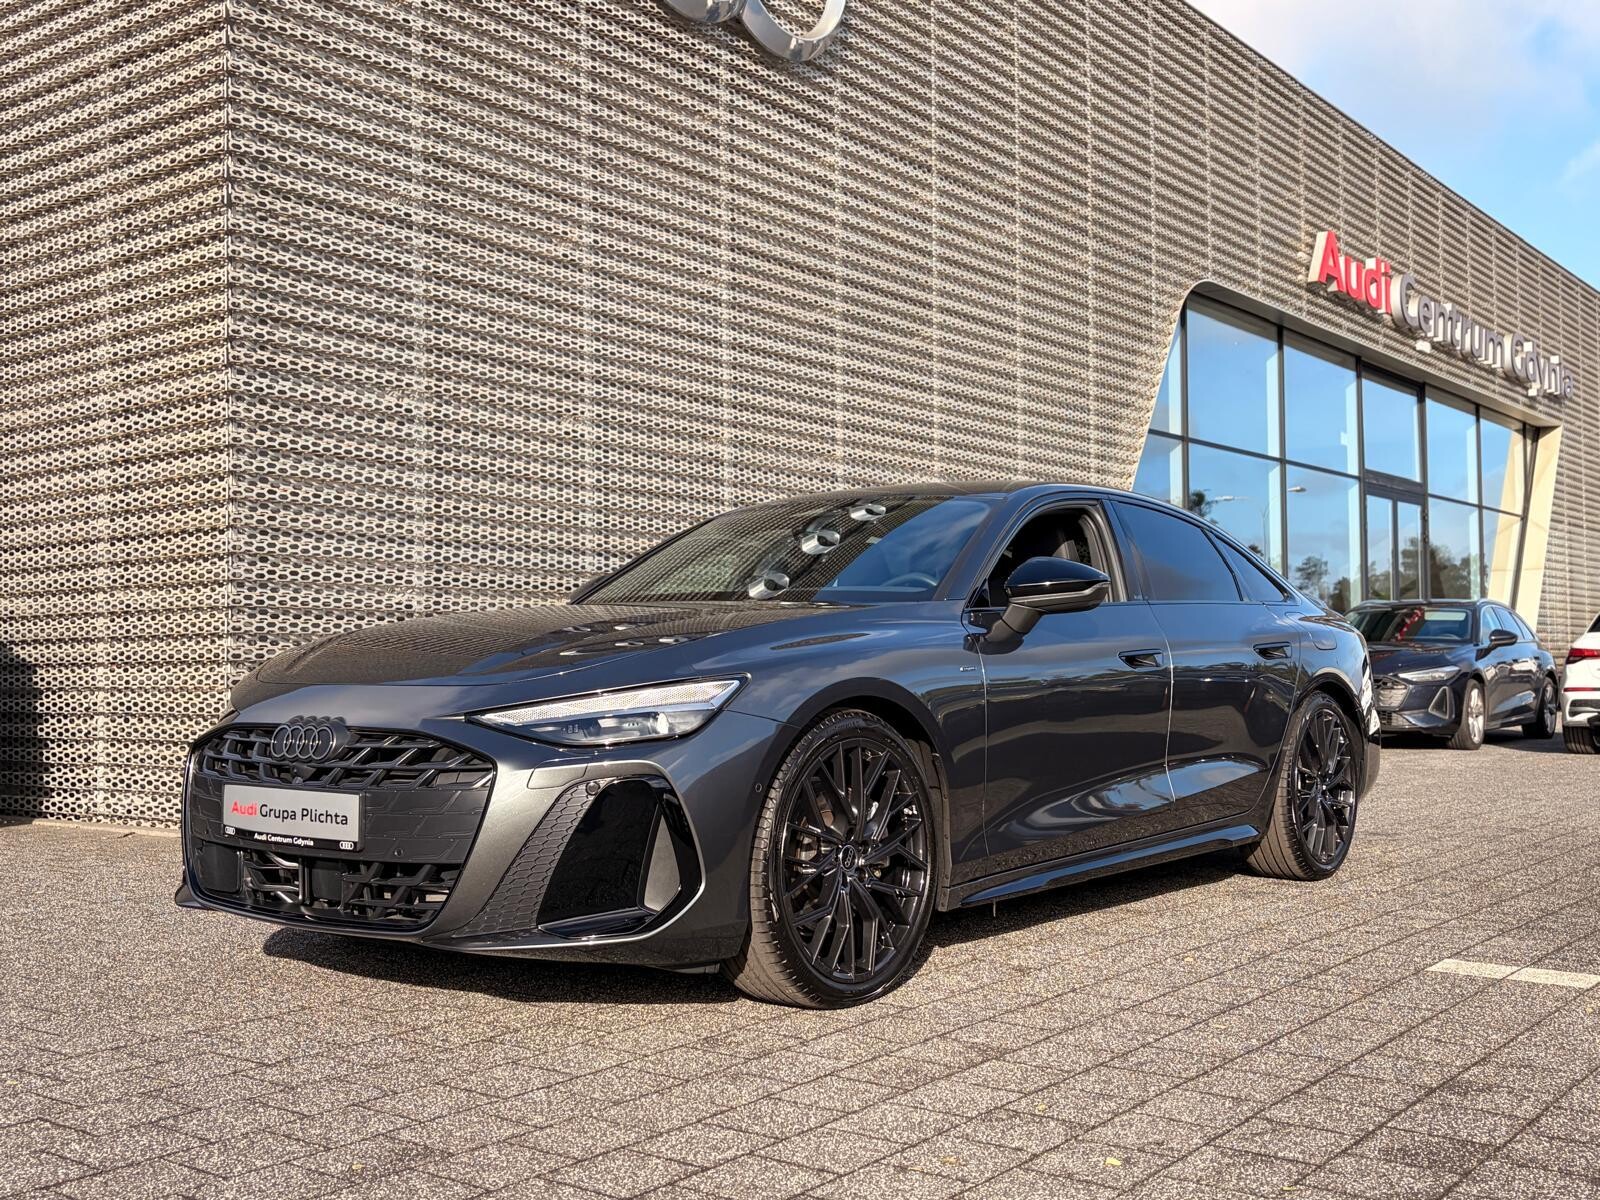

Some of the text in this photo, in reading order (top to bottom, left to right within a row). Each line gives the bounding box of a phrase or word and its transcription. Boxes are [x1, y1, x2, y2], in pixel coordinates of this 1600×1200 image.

[1309, 230, 1574, 399] Audi Centrum Gdynia
[231, 801, 348, 825] Audi Grupa Plichta
[254, 832, 314, 847] Audi Centrum Gdynia
